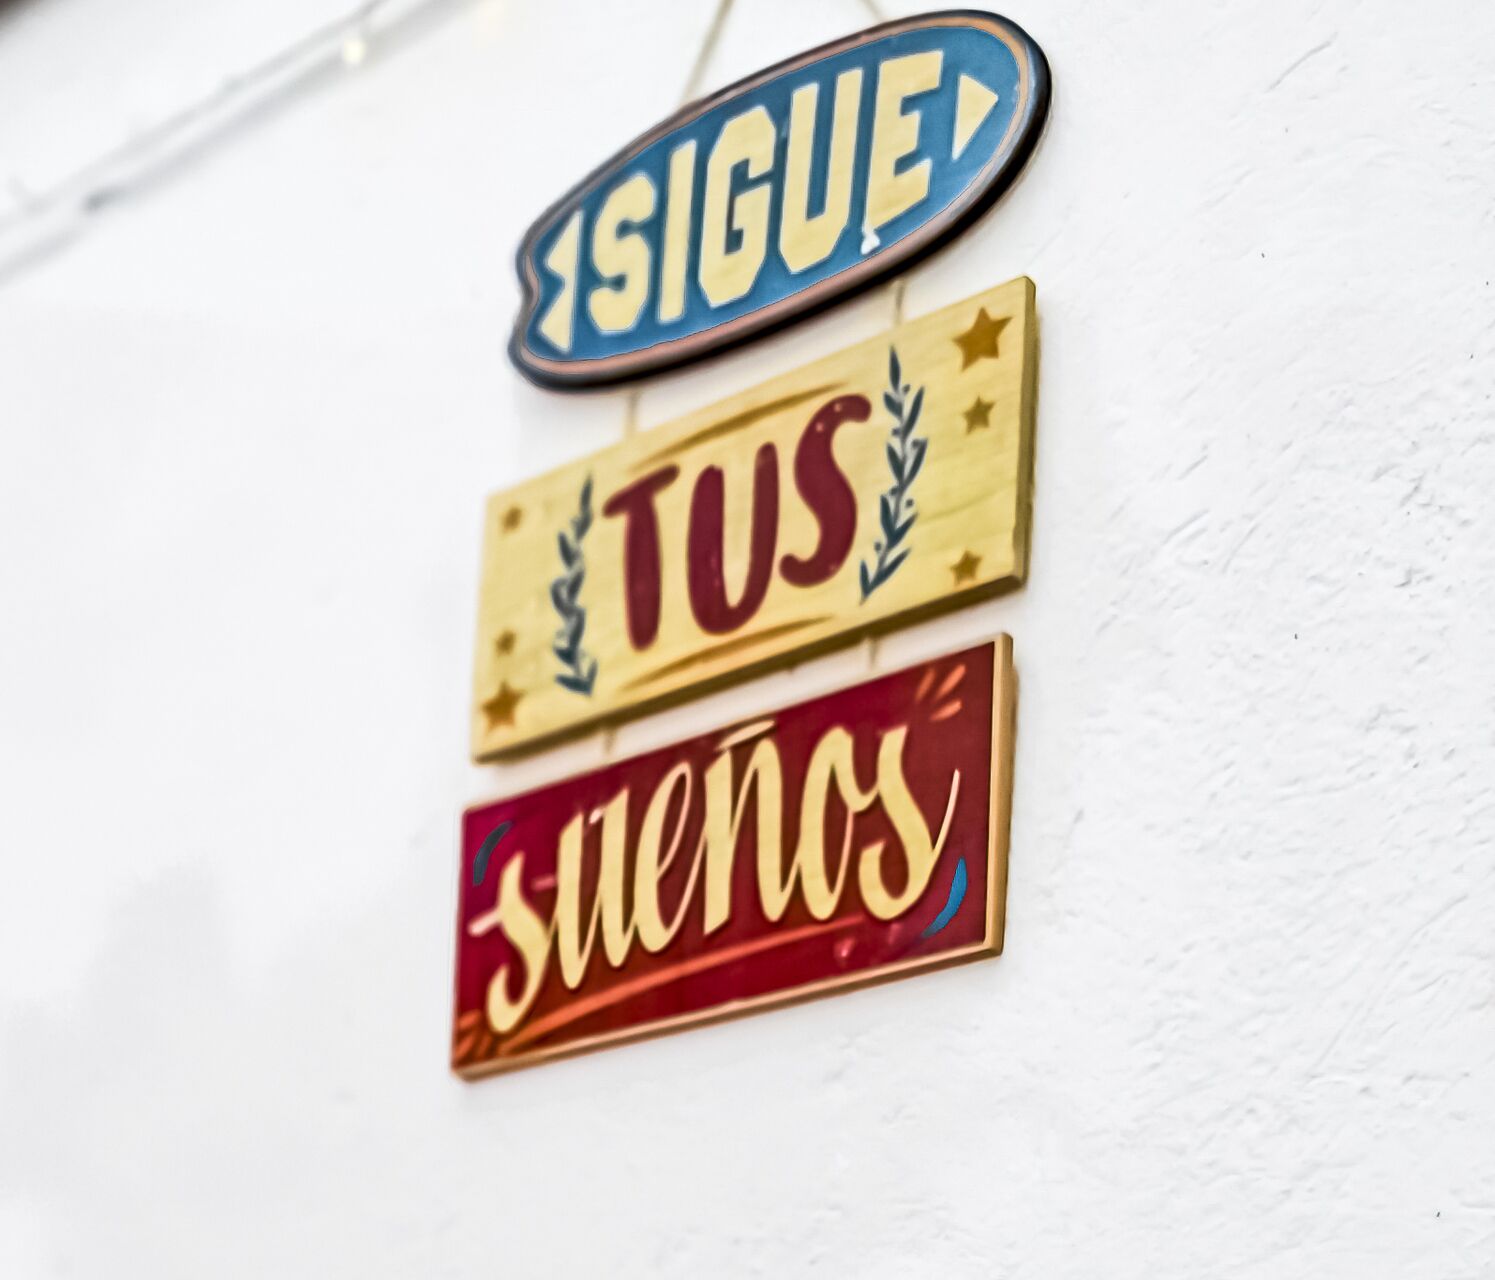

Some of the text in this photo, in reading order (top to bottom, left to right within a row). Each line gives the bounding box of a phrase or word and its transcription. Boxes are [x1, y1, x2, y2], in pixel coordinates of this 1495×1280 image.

[588, 50, 943, 333] SIGUE
[602, 393, 872, 652] TUS
[467, 719, 960, 1033] sueños
